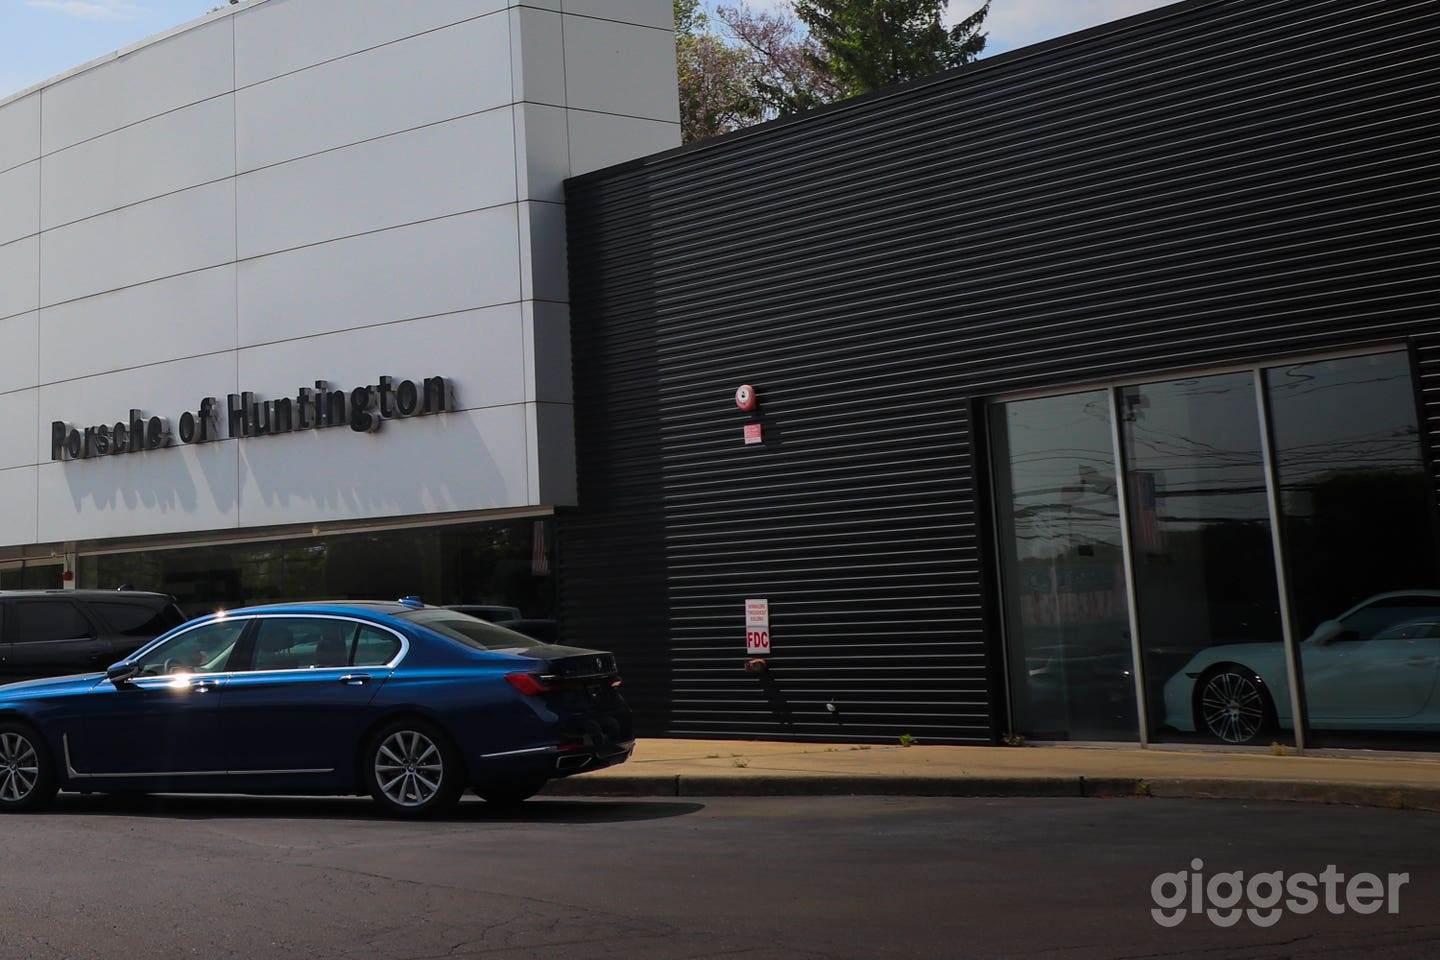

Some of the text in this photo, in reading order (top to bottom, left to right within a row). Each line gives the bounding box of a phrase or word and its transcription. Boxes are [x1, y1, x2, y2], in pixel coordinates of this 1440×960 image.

[51, 375, 453, 461] Porsche of Huntington
[747, 632, 768, 648] FDC
